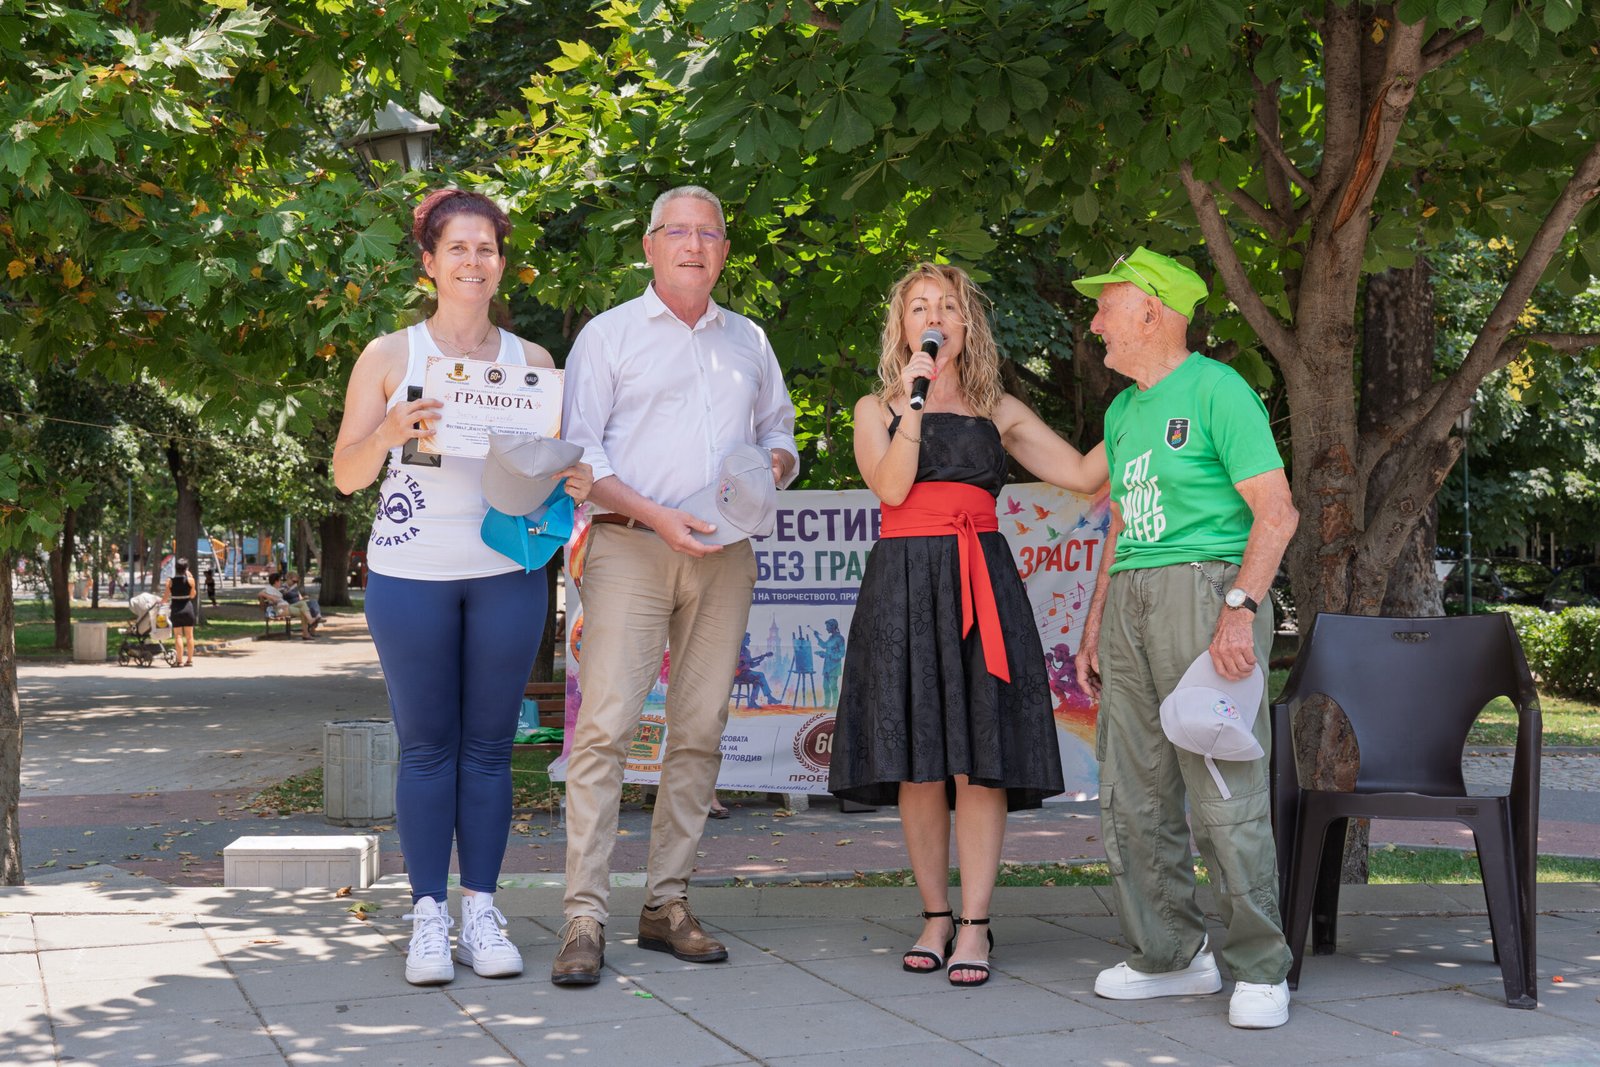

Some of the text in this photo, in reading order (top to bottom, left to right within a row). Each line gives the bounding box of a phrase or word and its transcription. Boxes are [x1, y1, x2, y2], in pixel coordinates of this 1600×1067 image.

[454, 391, 533, 410] ГРАМОТА
[1122, 448, 1153, 492] EAT
[404, 474, 426, 510] TEAM
[1120, 475, 1163, 529] MOVE
[754, 551, 805, 581] БЕЗ
[814, 551, 871, 581] ГРА
[758, 592, 770, 601] НА
[772, 592, 838, 602] ТВОРЧЕСТВОТО,
[723, 753, 763, 762] ПЛОВДИВ
